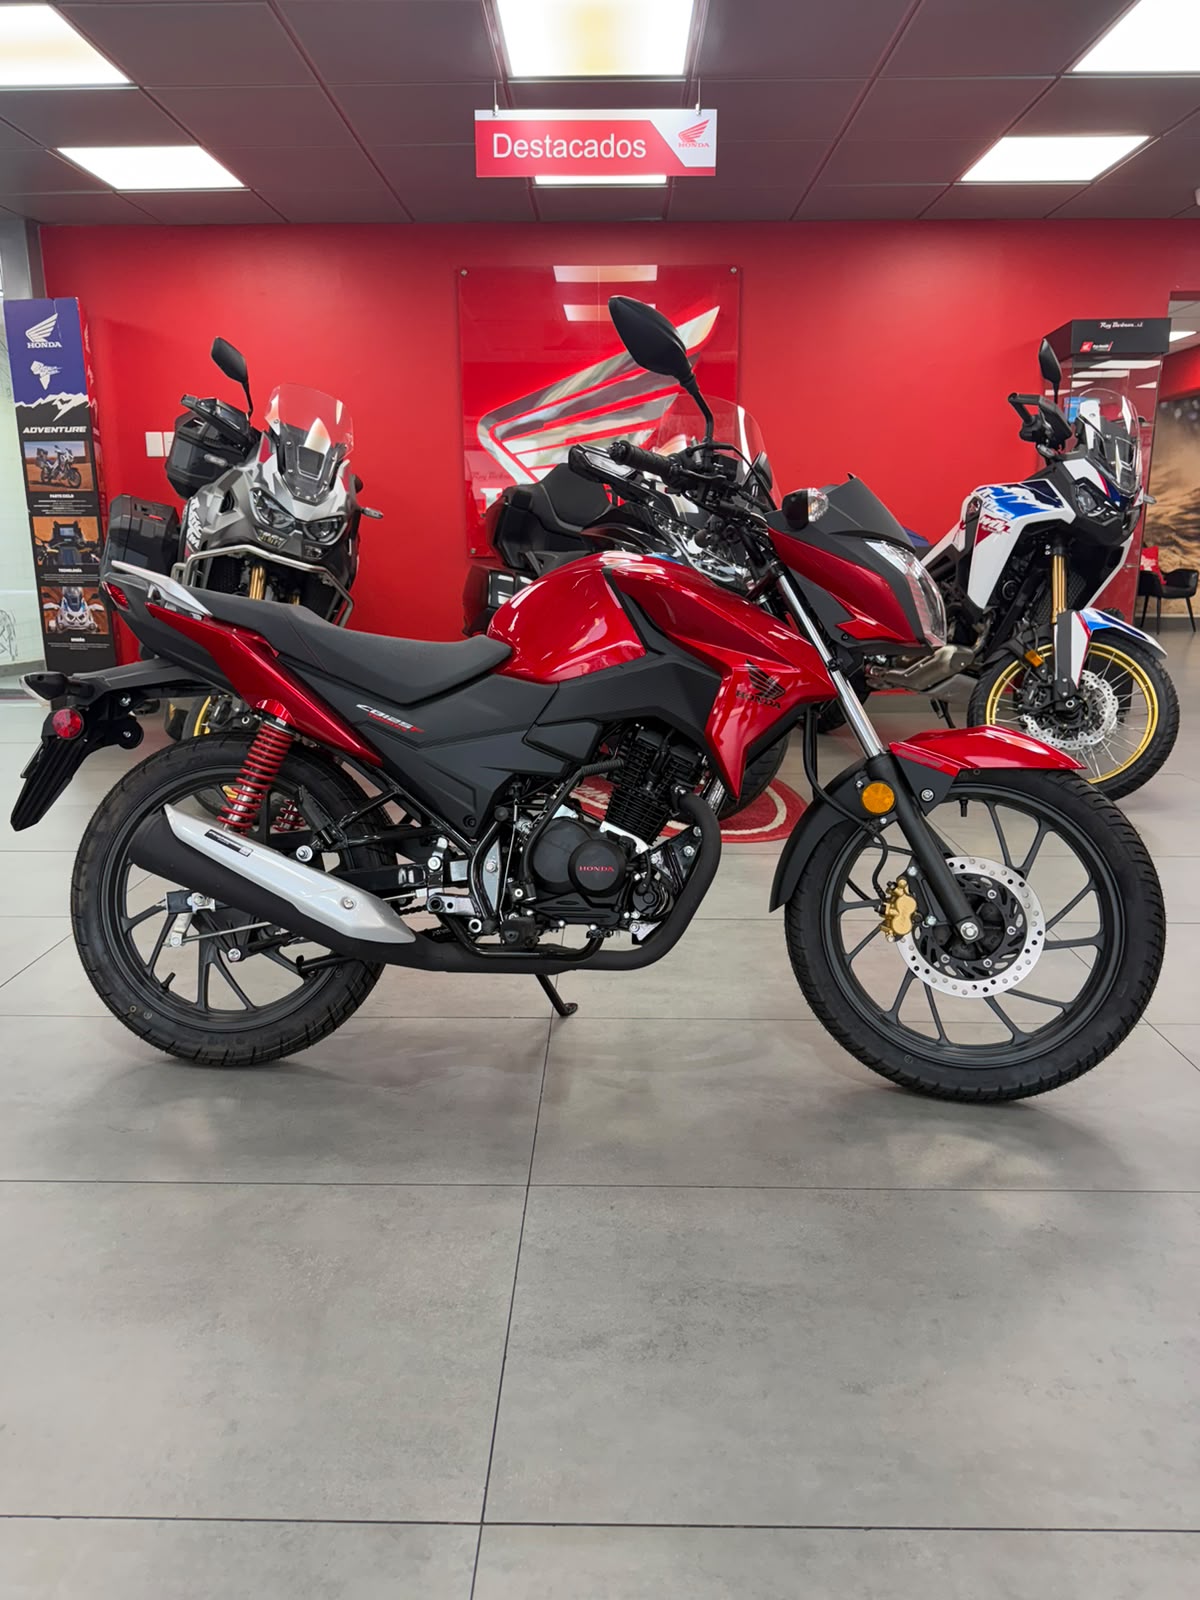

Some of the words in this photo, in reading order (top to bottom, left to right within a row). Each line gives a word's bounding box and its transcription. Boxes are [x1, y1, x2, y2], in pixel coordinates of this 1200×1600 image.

[493, 133, 647, 159] Destacados
[27, 341, 62, 349] HONDA
[23, 426, 87, 434] ADVENTURE
[736, 690, 781, 710] HONDA
